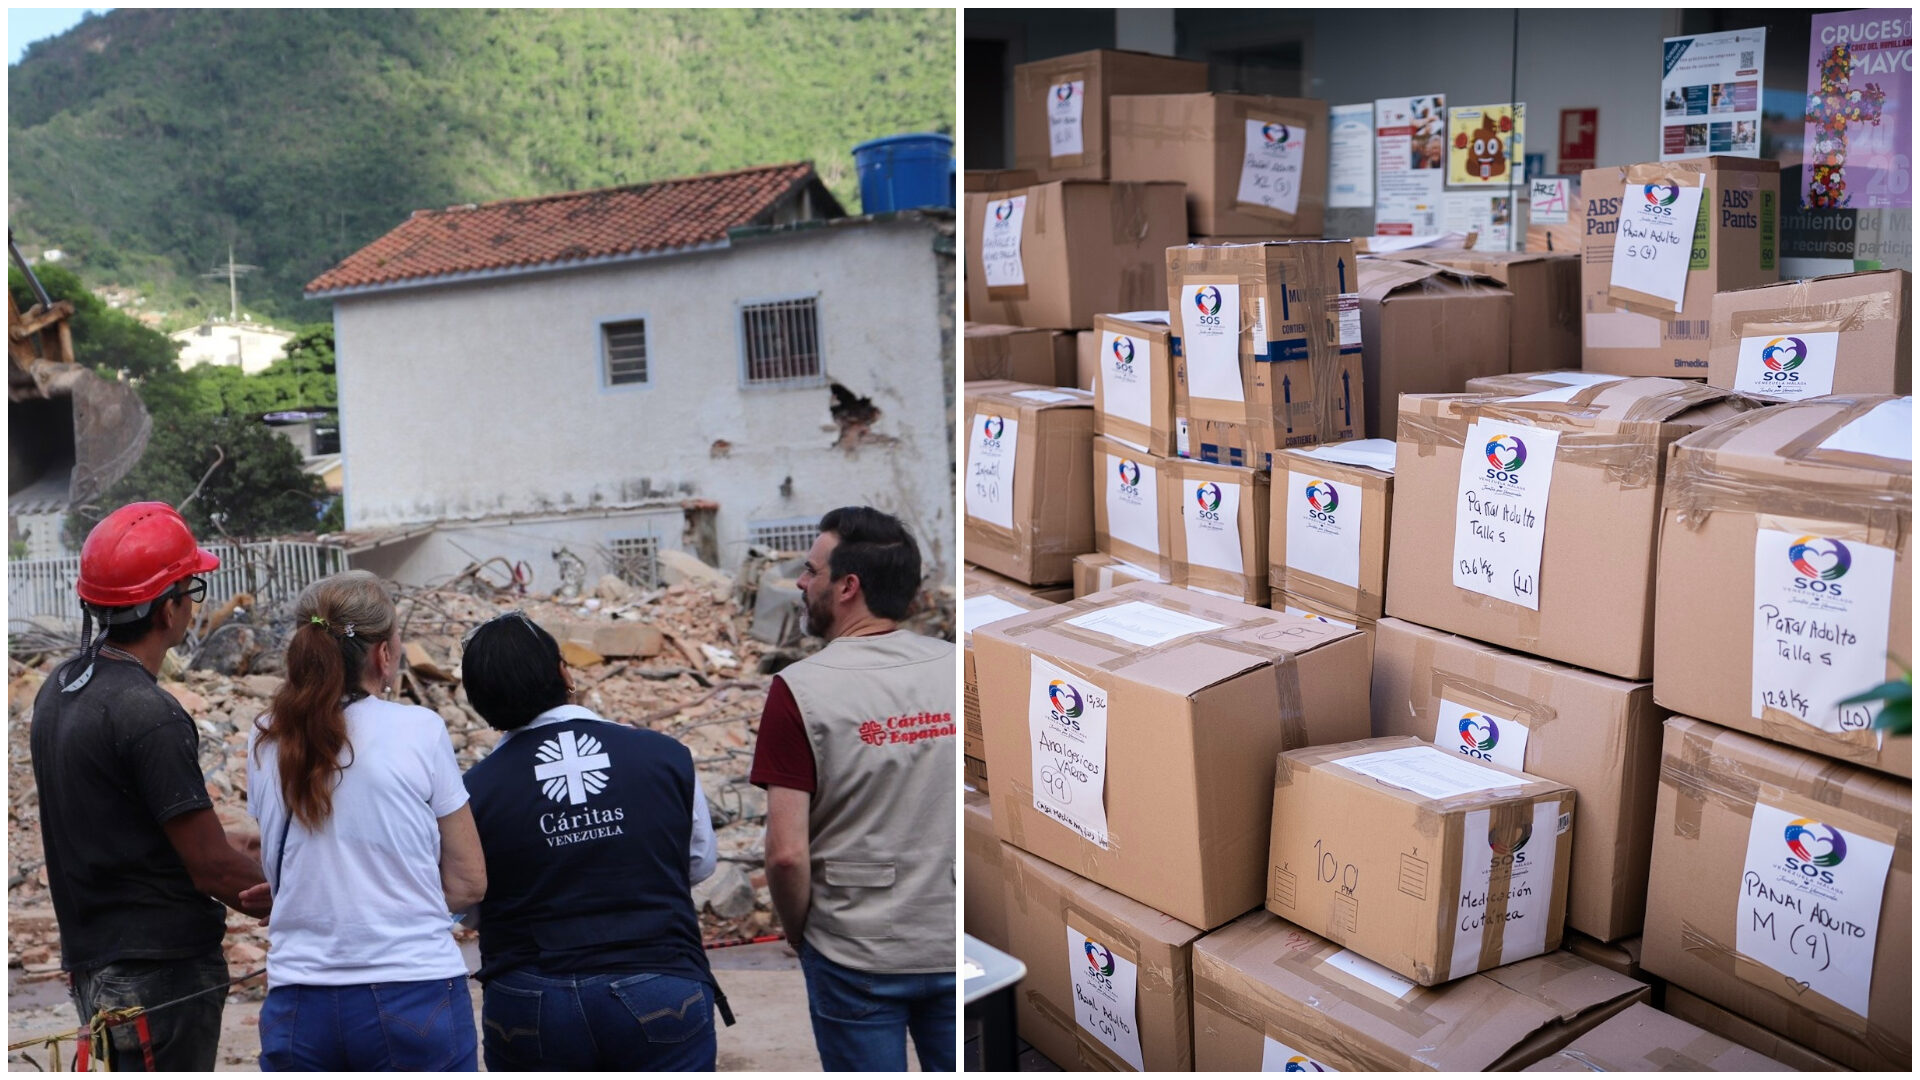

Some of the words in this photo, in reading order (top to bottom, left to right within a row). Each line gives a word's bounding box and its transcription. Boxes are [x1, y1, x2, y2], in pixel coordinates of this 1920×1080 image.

[1821, 19, 1902, 45] CRUCES
[1867, 42, 1878, 50] DEL
[1867, 154, 1909, 195] 26
[1644, 204, 1673, 216] SOS
[1722, 209, 1757, 229] Pants
[1650, 230, 1680, 244] Adulto
[1793, 240, 1854, 253] recursos
[1691, 248, 1707, 260] 60
[1200, 316, 1220, 325] SOS
[1115, 361, 1134, 374] SOS
[1763, 371, 1799, 382] SOS
[984, 438, 1001, 449] SOS
[1486, 468, 1519, 485] SOS
[1121, 483, 1139, 496] SOS
[1199, 510, 1219, 521] SOS
[1309, 509, 1336, 524] SOS
[1470, 520, 1494, 543] Talla
[1794, 577, 1842, 596] SOS
[1809, 620, 1857, 646] Adulto
[1777, 639, 1812, 664] Talla
[1762, 690, 1788, 711] 12.8
[887, 712, 951, 729] Cáritas
[1051, 710, 1081, 731] SOS
[889, 724, 956, 744] Español
[1459, 745, 1492, 763] SOS
[540, 806, 625, 835] Cáritas
[546, 825, 624, 847] VENEZUELA
[1490, 851, 1526, 868] SOS
[1785, 857, 1834, 885] SOS
[1461, 881, 1532, 908] Medicación
[1461, 909, 1525, 931] Cutánea
[1753, 907, 1776, 941] M
[1790, 924, 1831, 972] (9)
[1088, 966, 1113, 990] SOS
